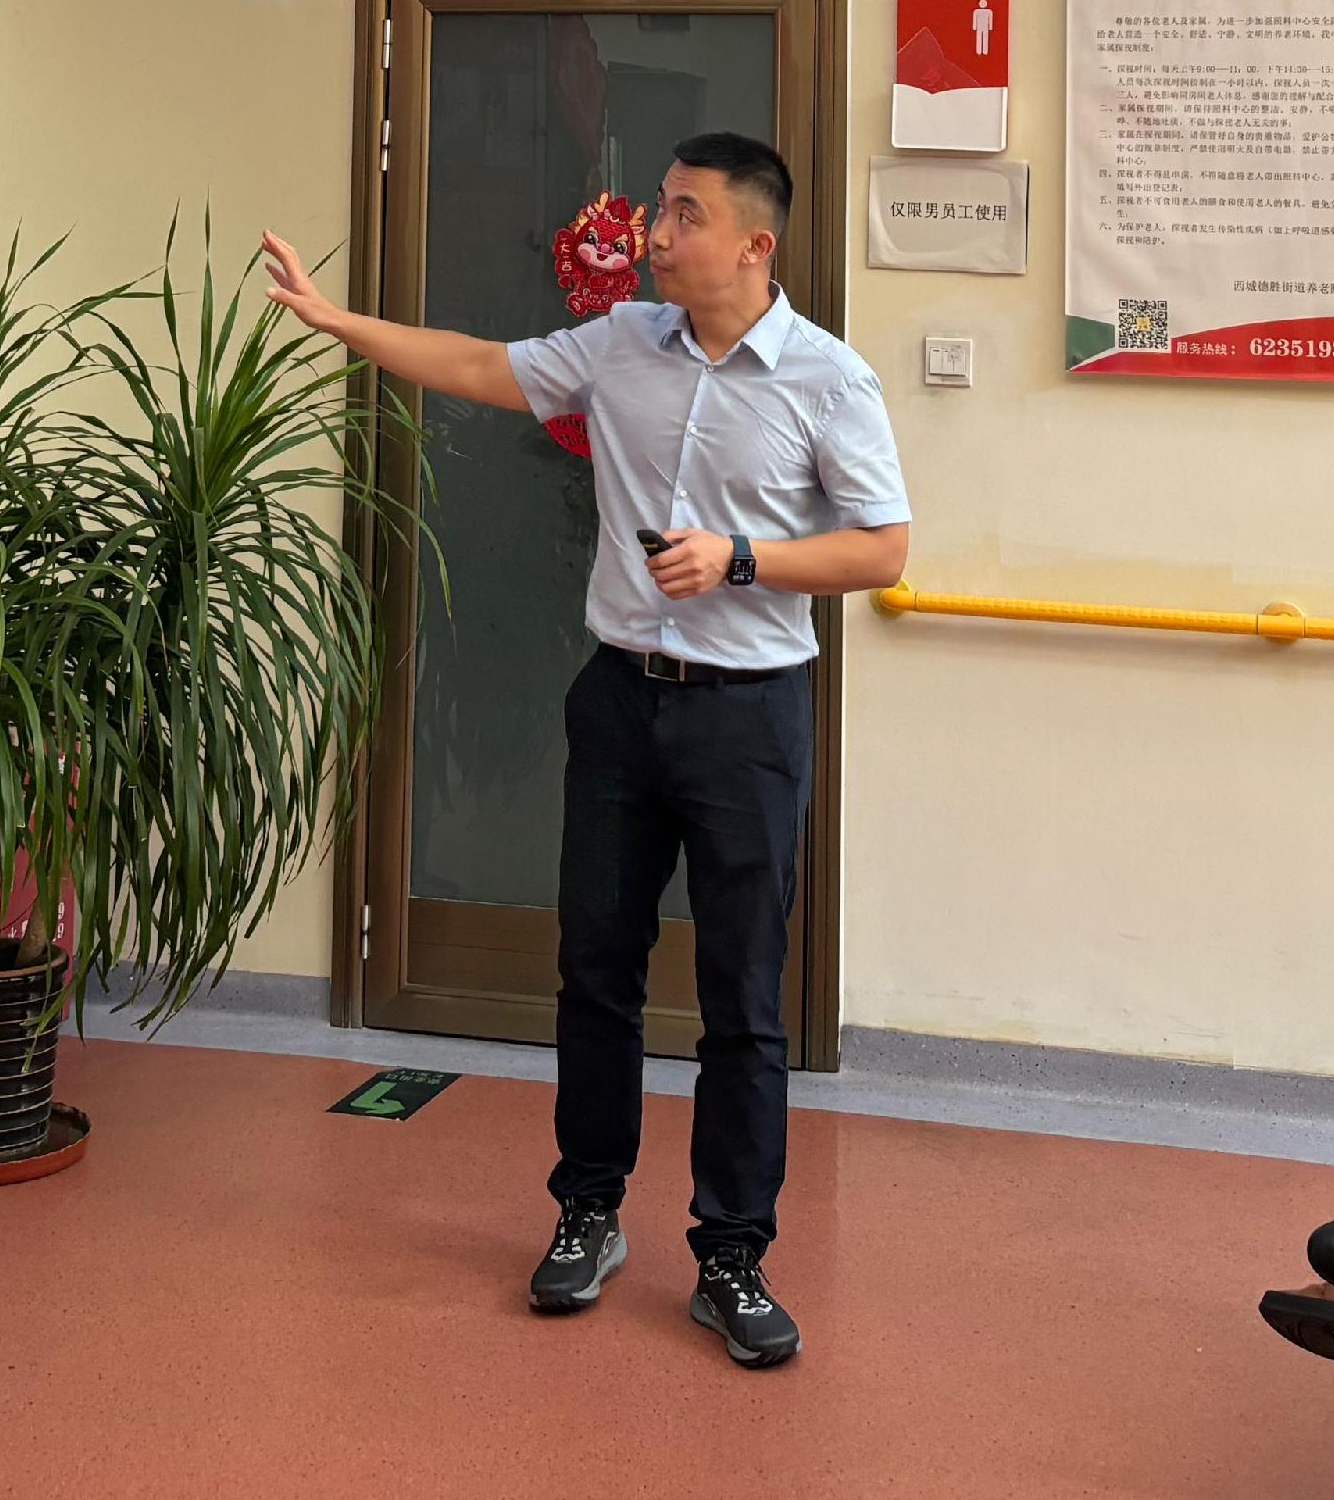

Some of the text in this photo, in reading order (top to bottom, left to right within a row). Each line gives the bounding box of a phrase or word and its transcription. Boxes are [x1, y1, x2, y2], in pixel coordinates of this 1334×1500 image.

[889, 200, 1008, 222] 仅限男员工使用
[1176, 340, 1237, 357] 服务热线：
